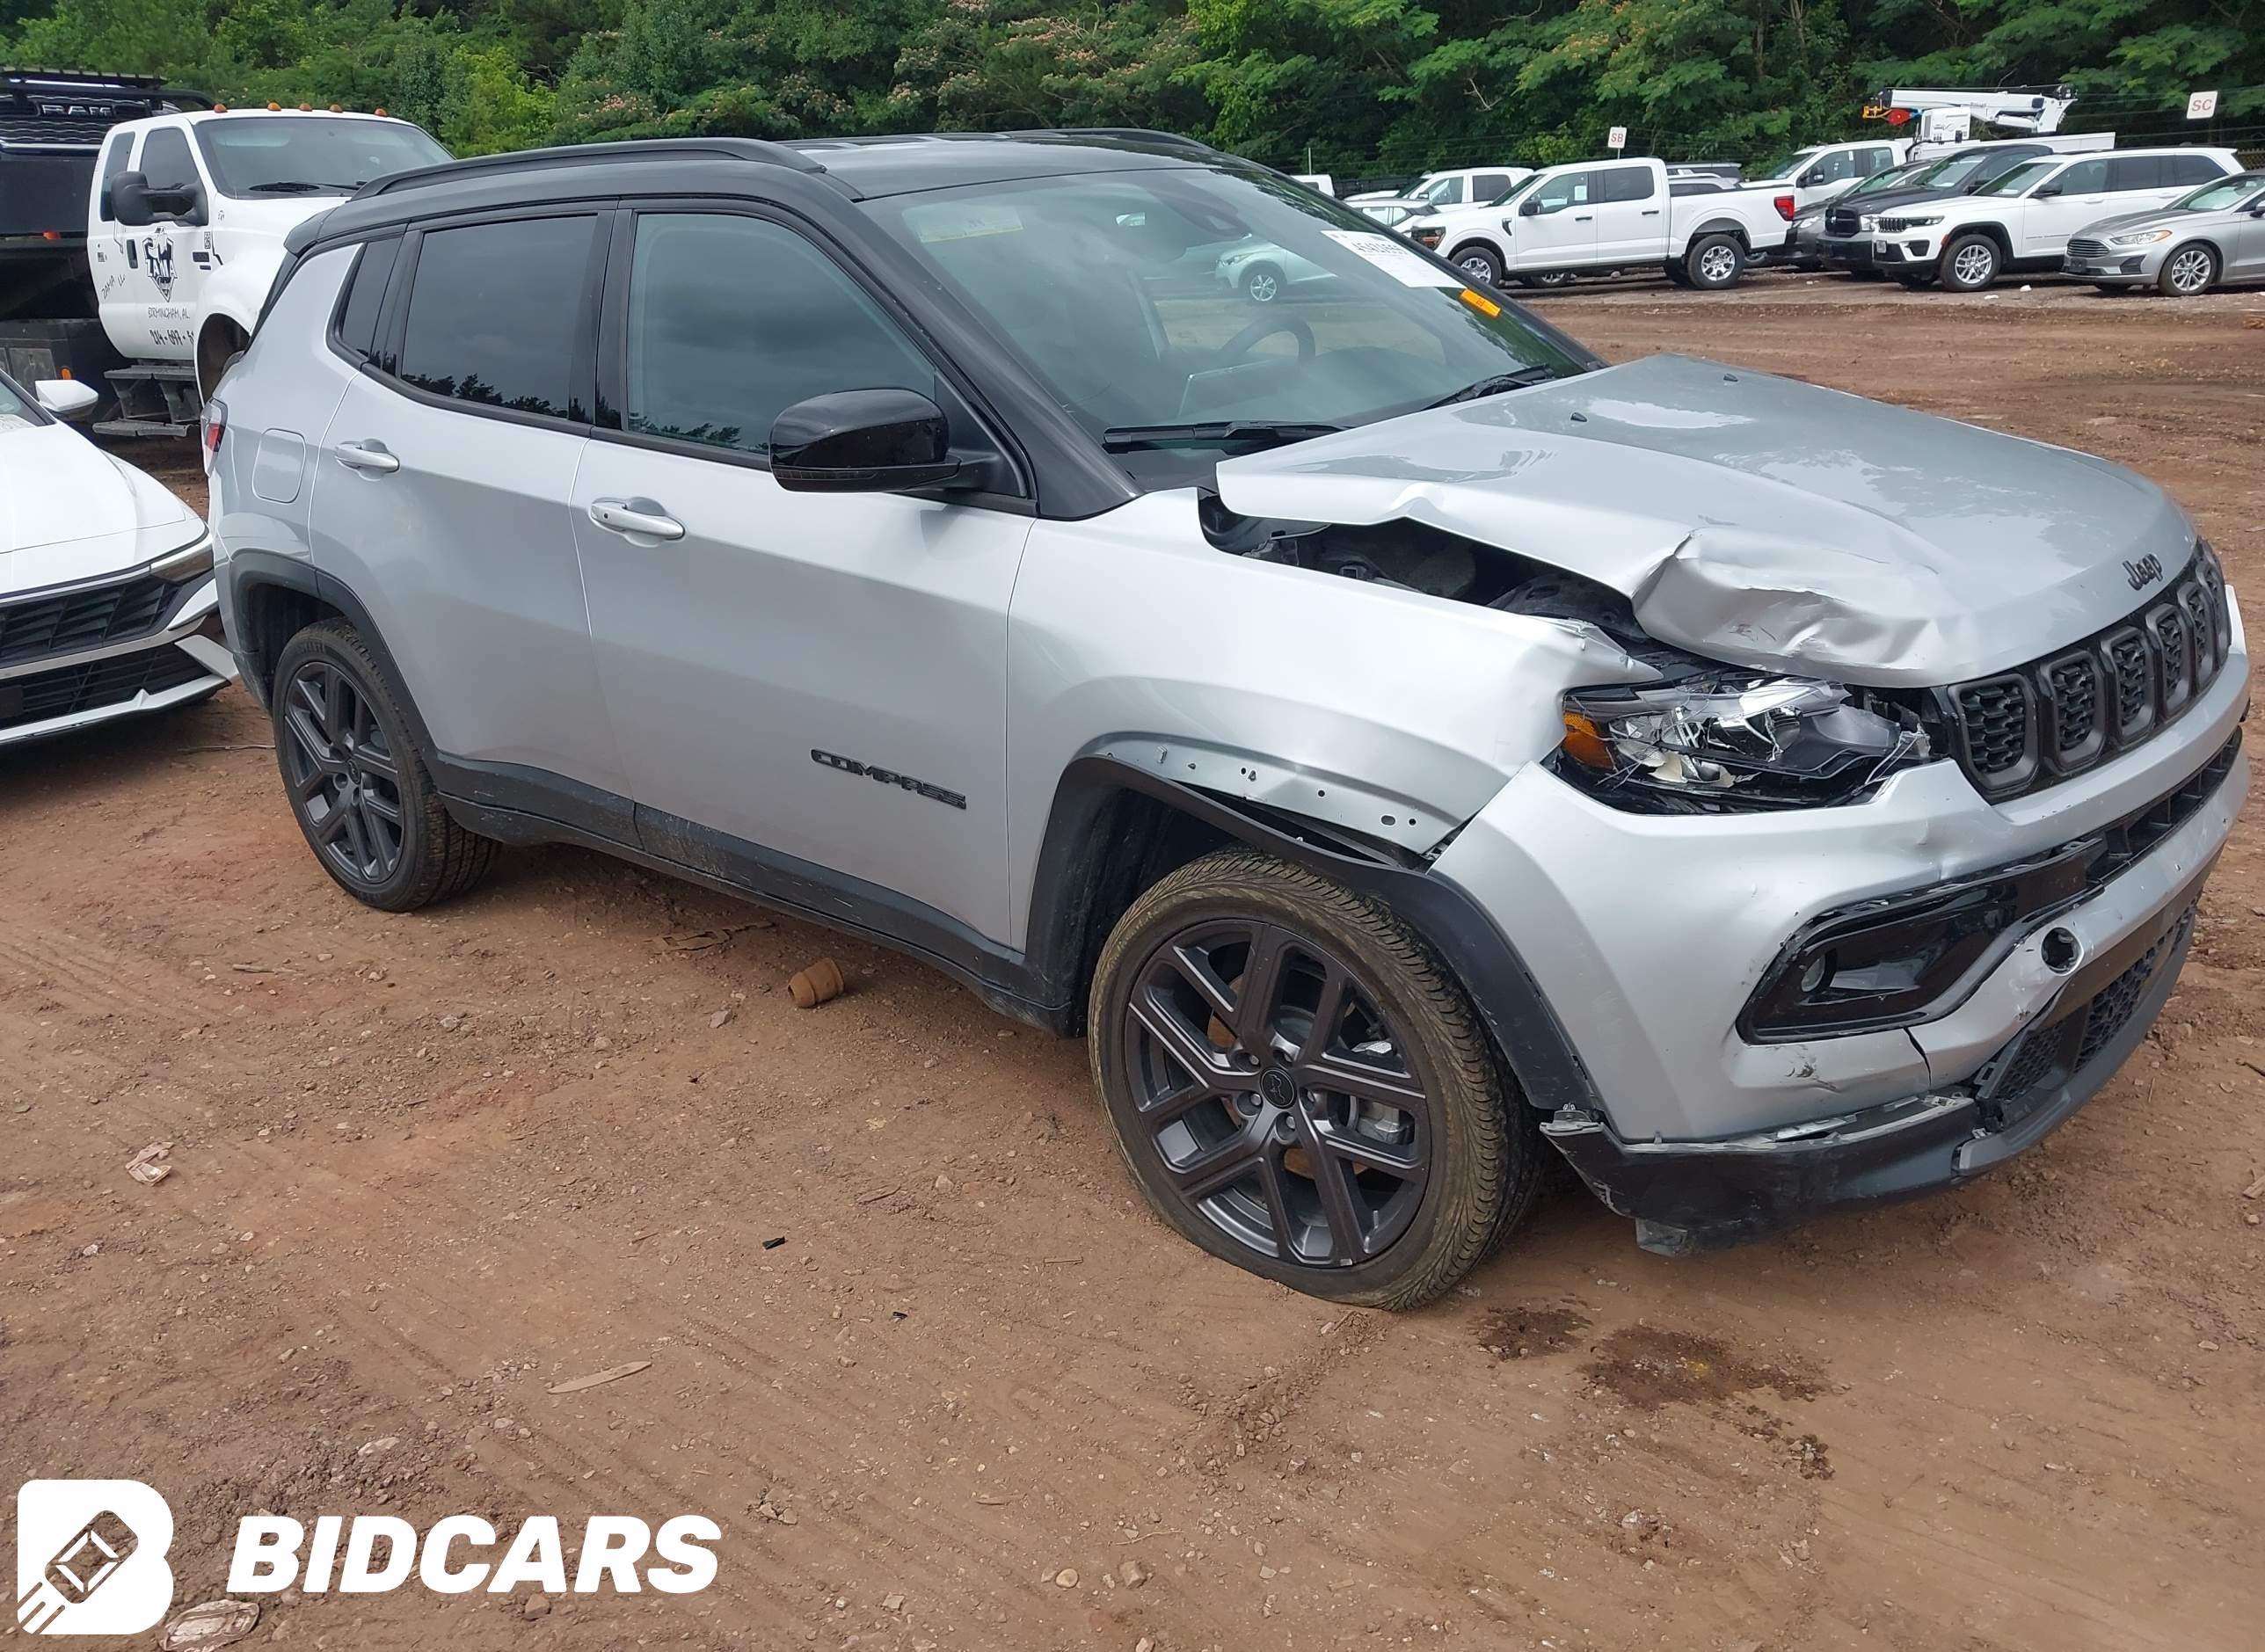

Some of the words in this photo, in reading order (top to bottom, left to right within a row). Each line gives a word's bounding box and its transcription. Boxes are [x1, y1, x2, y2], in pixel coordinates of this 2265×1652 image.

[41, 105, 113, 116] RAM
[2192, 98, 2212, 112] SC
[1611, 133, 1624, 142] SB
[145, 258, 177, 279] ZAMA
[2122, 553, 2163, 591] Jeep
[811, 748, 966, 810] COMPASS
